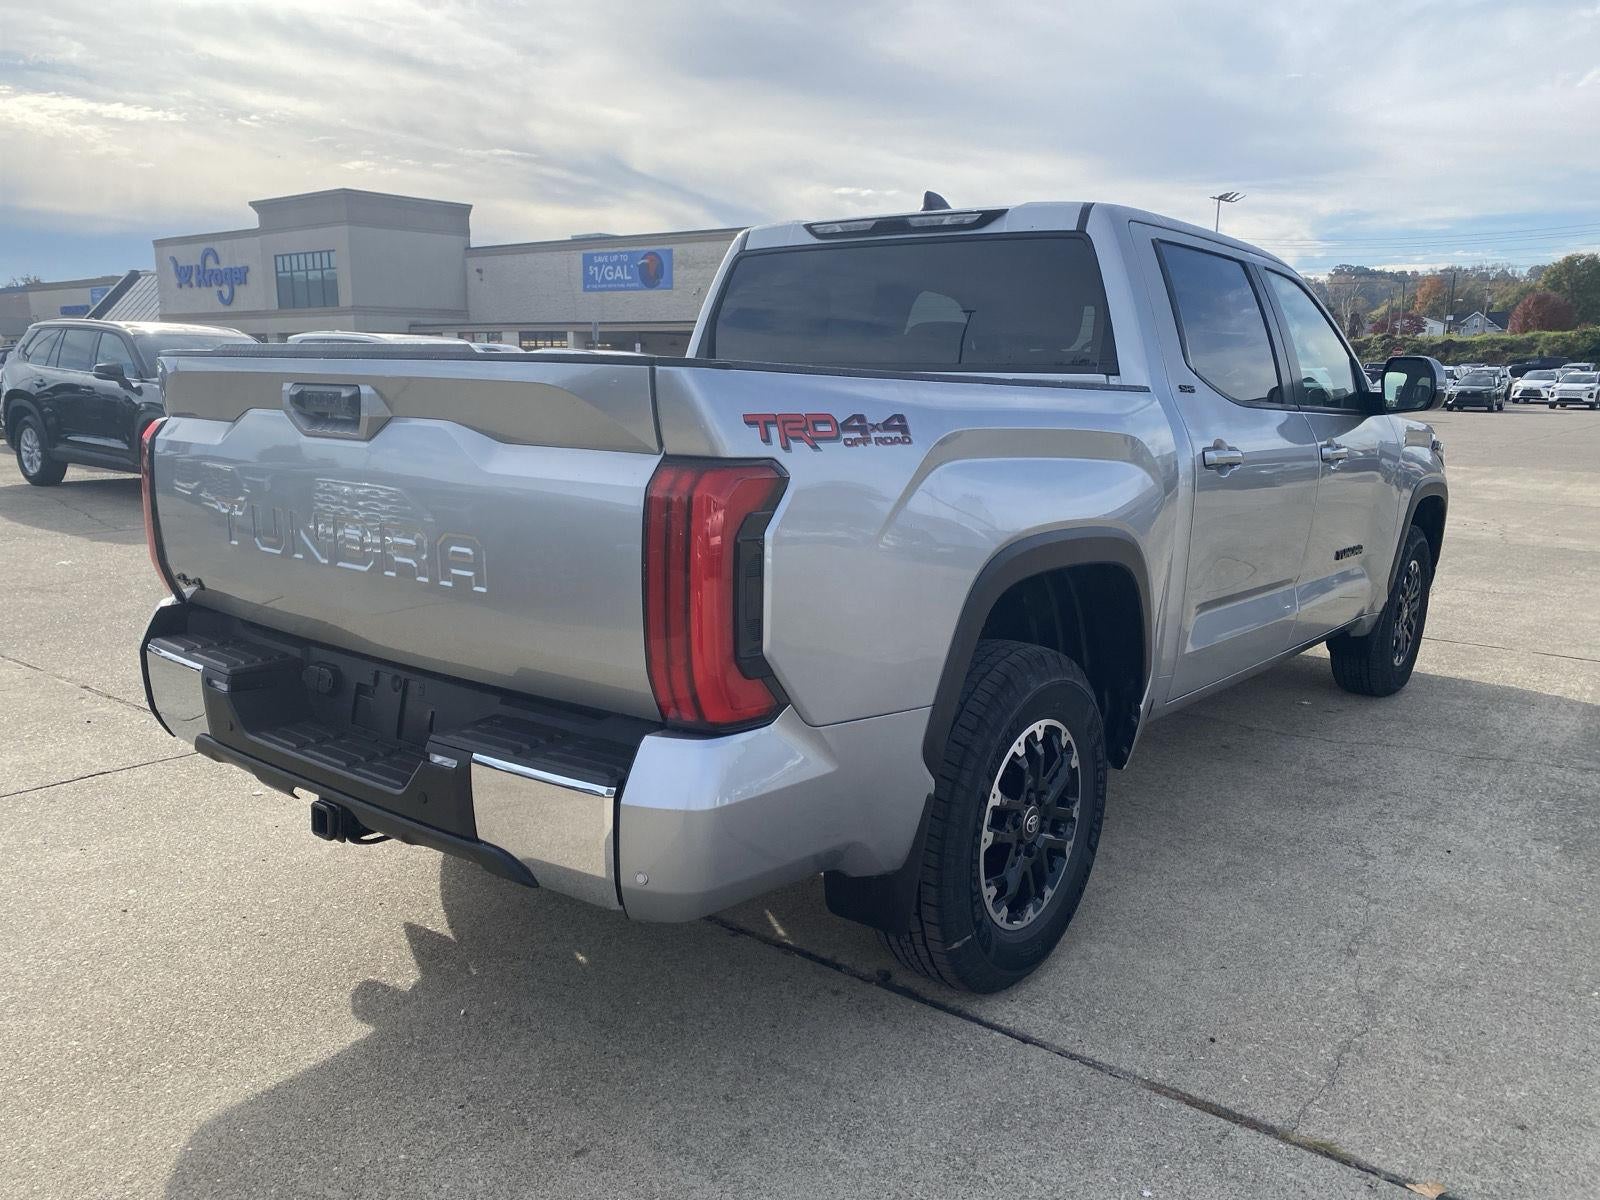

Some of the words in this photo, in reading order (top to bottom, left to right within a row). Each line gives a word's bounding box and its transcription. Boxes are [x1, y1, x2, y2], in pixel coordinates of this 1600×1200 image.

[195, 248, 249, 306] Kroger
[593, 255, 609, 263] SAVE
[620, 254, 629, 262] TO
[742, 413, 843, 453] TRD
[843, 437, 872, 448] OFF
[874, 435, 913, 447] ROAD
[216, 496, 488, 593] TUNDRA
